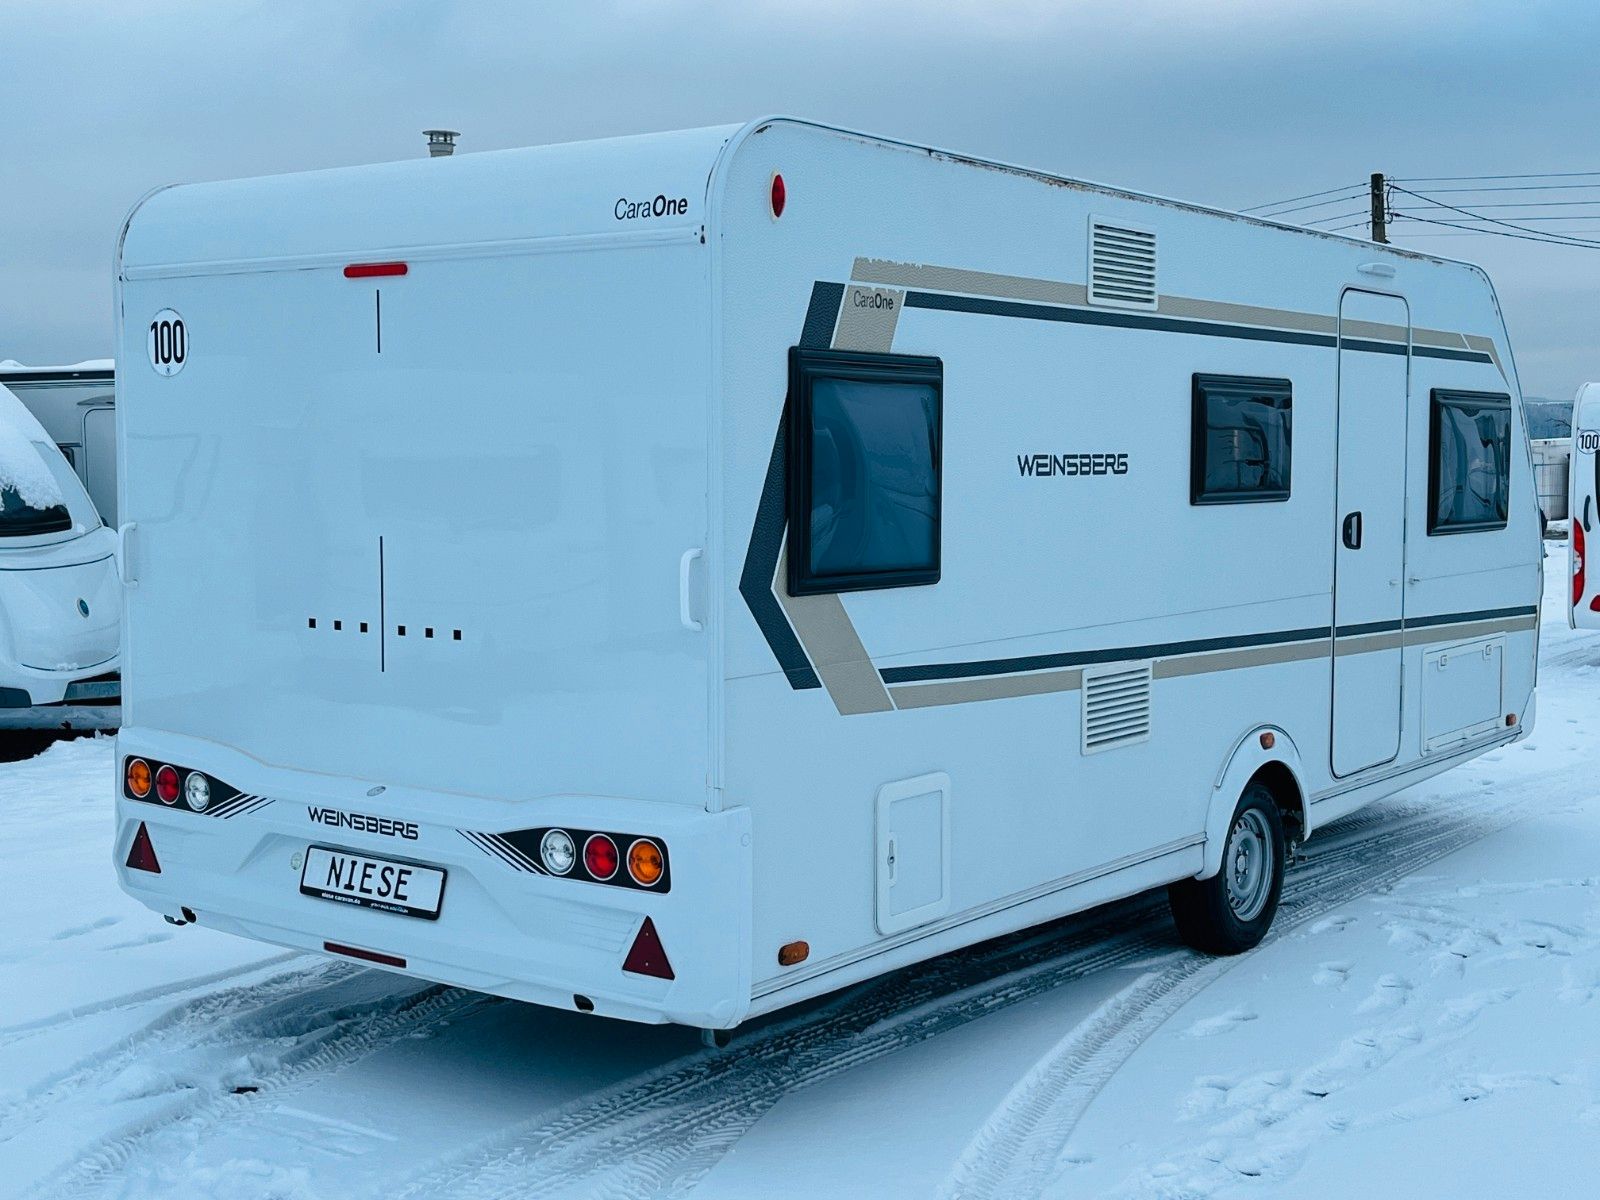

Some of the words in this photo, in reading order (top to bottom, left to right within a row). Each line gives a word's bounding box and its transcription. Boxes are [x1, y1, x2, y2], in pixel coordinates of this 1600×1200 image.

[614, 194, 688, 220] CaraOne
[853, 290, 894, 310] CaraOne
[150, 319, 185, 365] 100
[1580, 434, 1599, 450] 100
[1017, 453, 1129, 477] WEINSBERG
[307, 806, 419, 840] WEINSBERG
[326, 856, 412, 901] NIESE
